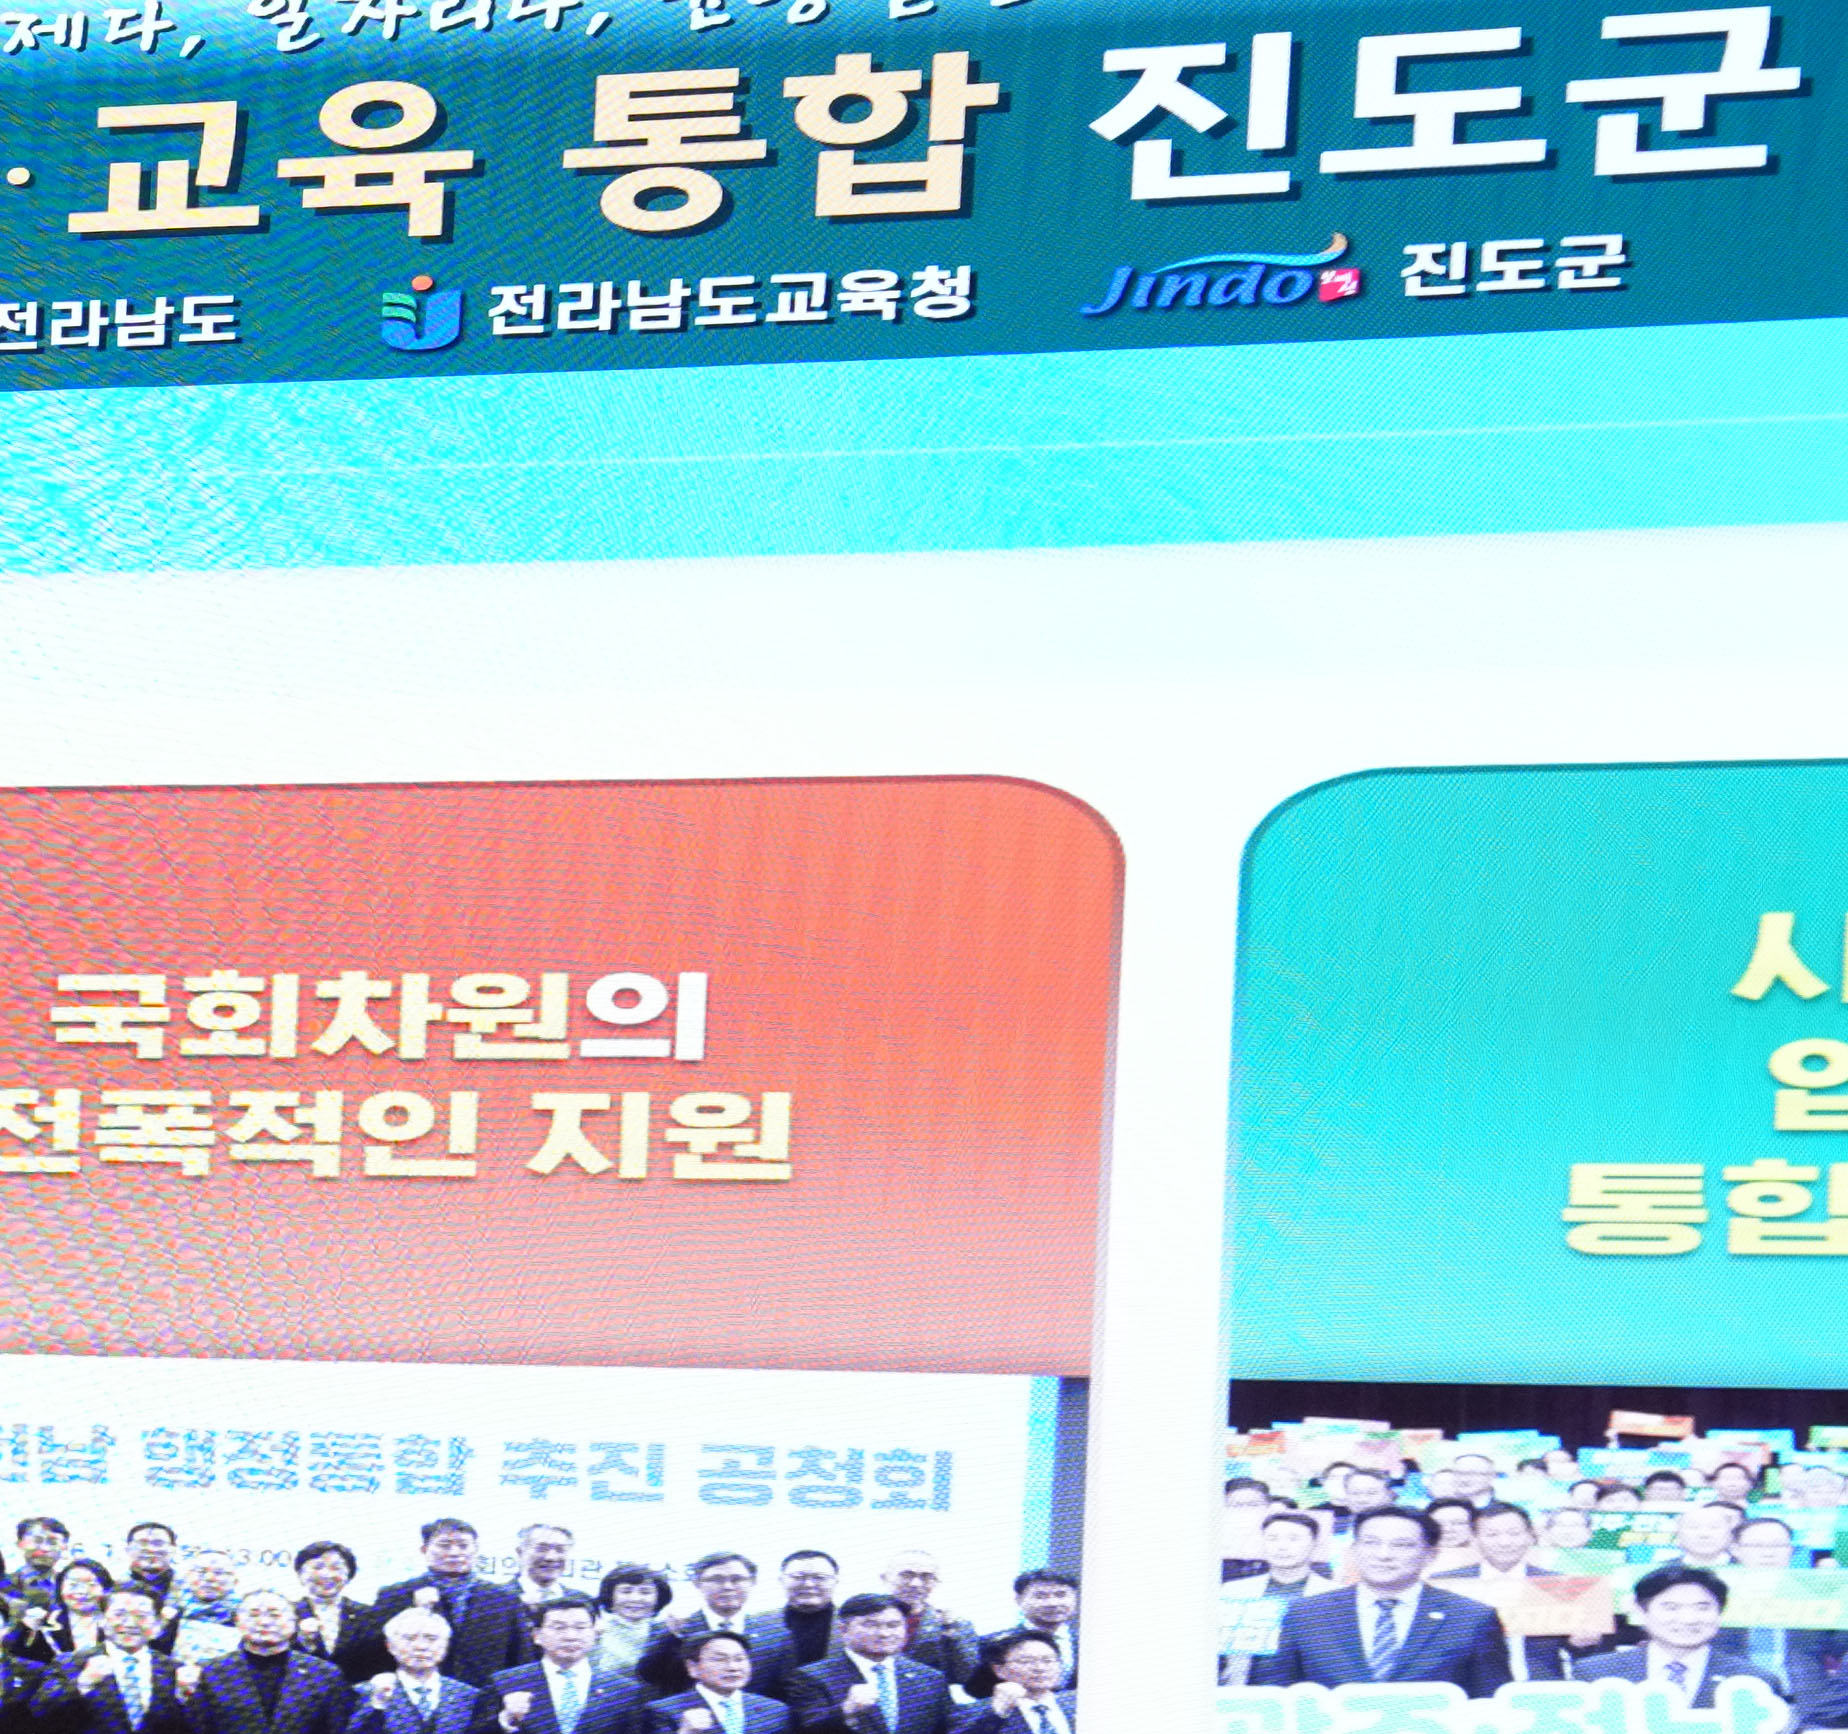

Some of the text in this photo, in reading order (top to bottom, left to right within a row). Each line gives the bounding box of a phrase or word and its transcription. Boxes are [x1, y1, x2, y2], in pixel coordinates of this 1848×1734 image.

[562, 48, 1001, 233] 통합
[1088, 5, 1802, 202] 진도군
[487, 265, 976, 335] 전라남도교육청
[1080, 263, 1314, 318] Jindo
[1401, 233, 1627, 297] 진도군
[48, 968, 709, 1062] 국회차원의
[523, 1086, 794, 1182] 지원
[140, 1426, 474, 1499] 행정통합
[502, 1436, 667, 1505] 추진
[696, 1440, 957, 1512] 공청회
